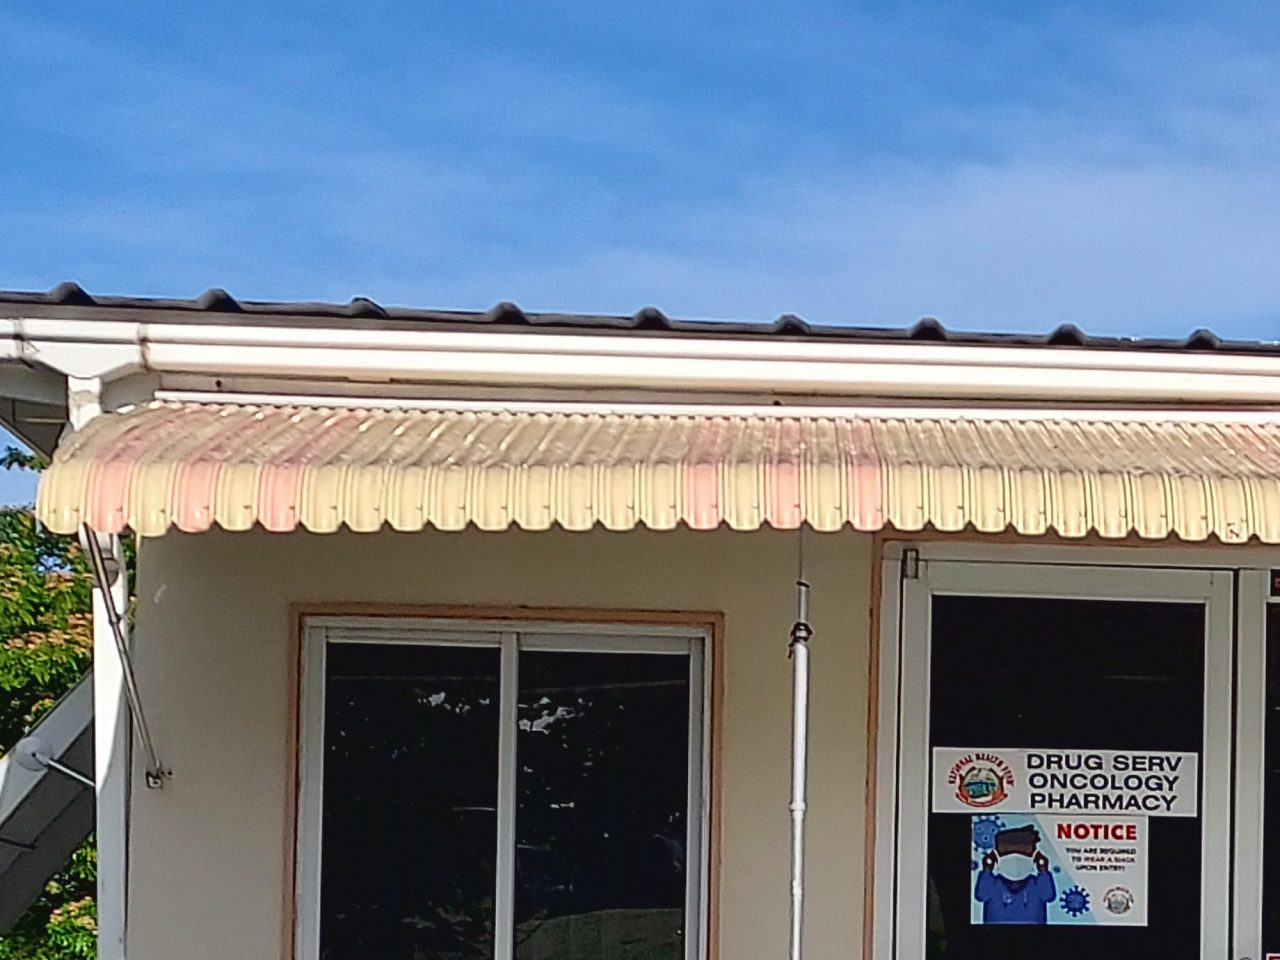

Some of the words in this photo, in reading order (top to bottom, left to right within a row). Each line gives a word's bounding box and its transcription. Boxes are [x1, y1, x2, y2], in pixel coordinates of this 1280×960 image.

[1026, 753, 1104, 771] DRUG
[1112, 755, 1183, 772] SERV
[1028, 772, 1180, 792] ONCOLOGY
[1030, 792, 1178, 811] PHARMACY
[1056, 823, 1137, 841] NOTICE
